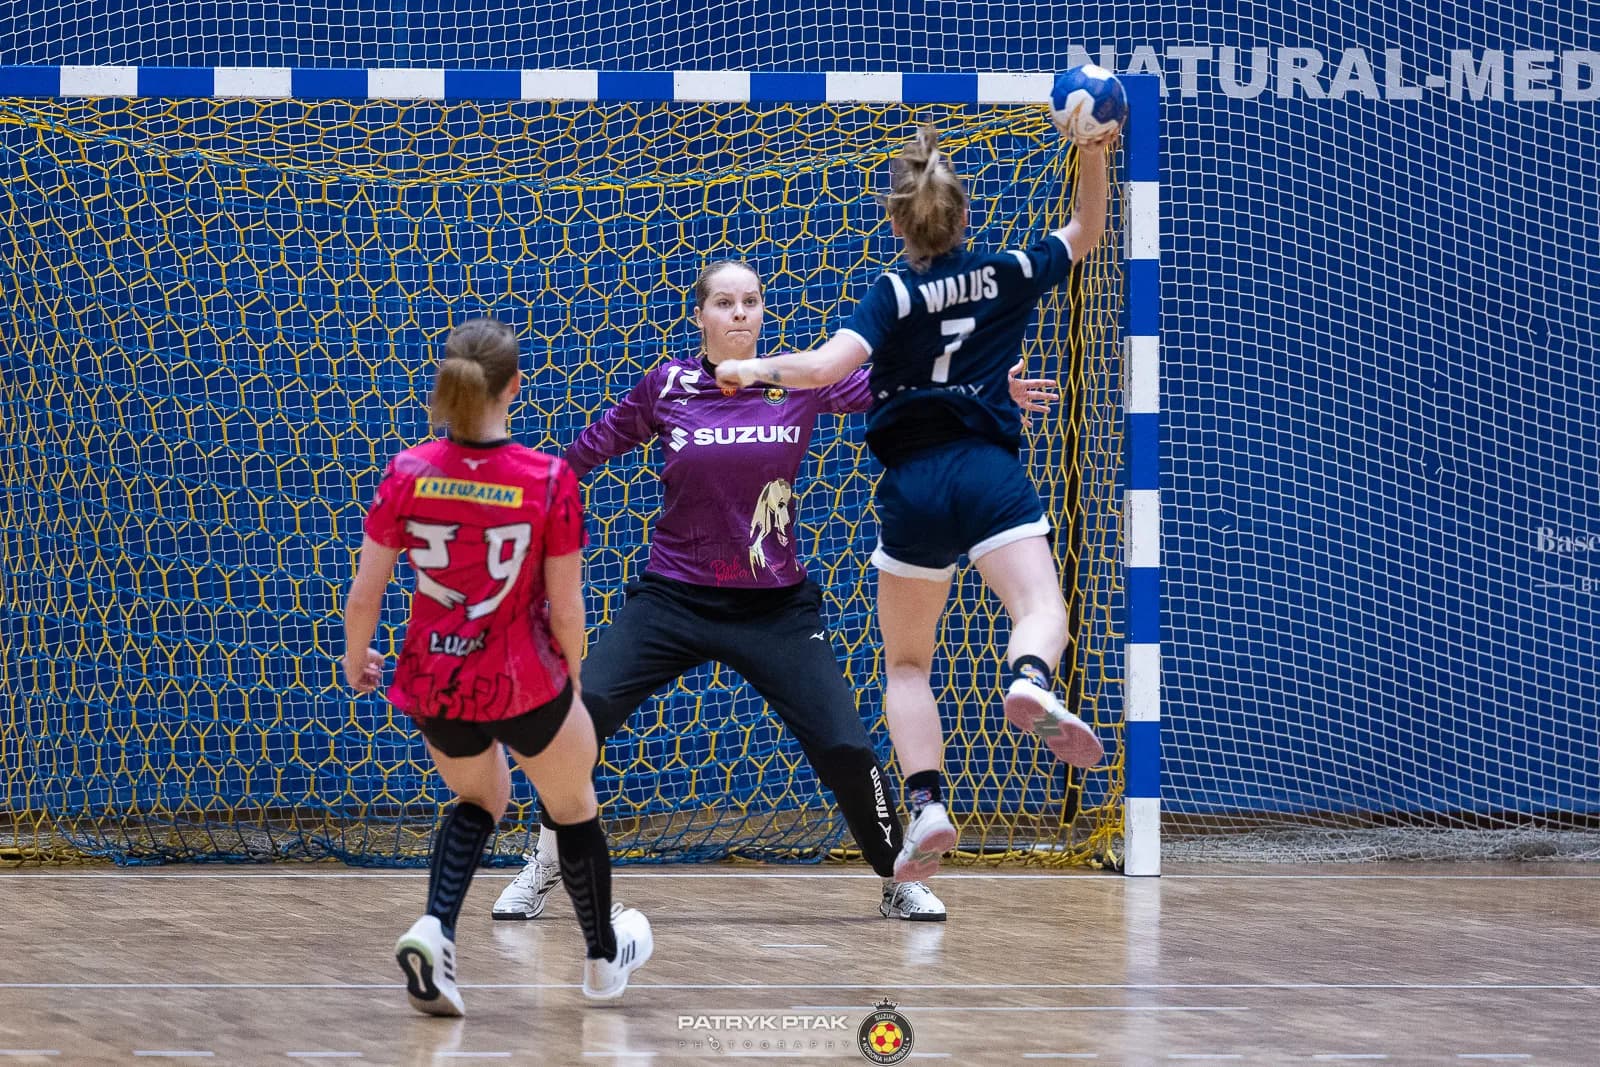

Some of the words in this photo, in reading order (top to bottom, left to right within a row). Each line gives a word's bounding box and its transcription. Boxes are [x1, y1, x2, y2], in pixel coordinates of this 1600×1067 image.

[918, 266, 998, 313] WALUS
[931, 317, 976, 383] 7
[658, 365, 702, 398] 12
[694, 425, 800, 446] SUZUKI
[405, 519, 532, 621] 39
[870, 766, 890, 819] MIZUNO
